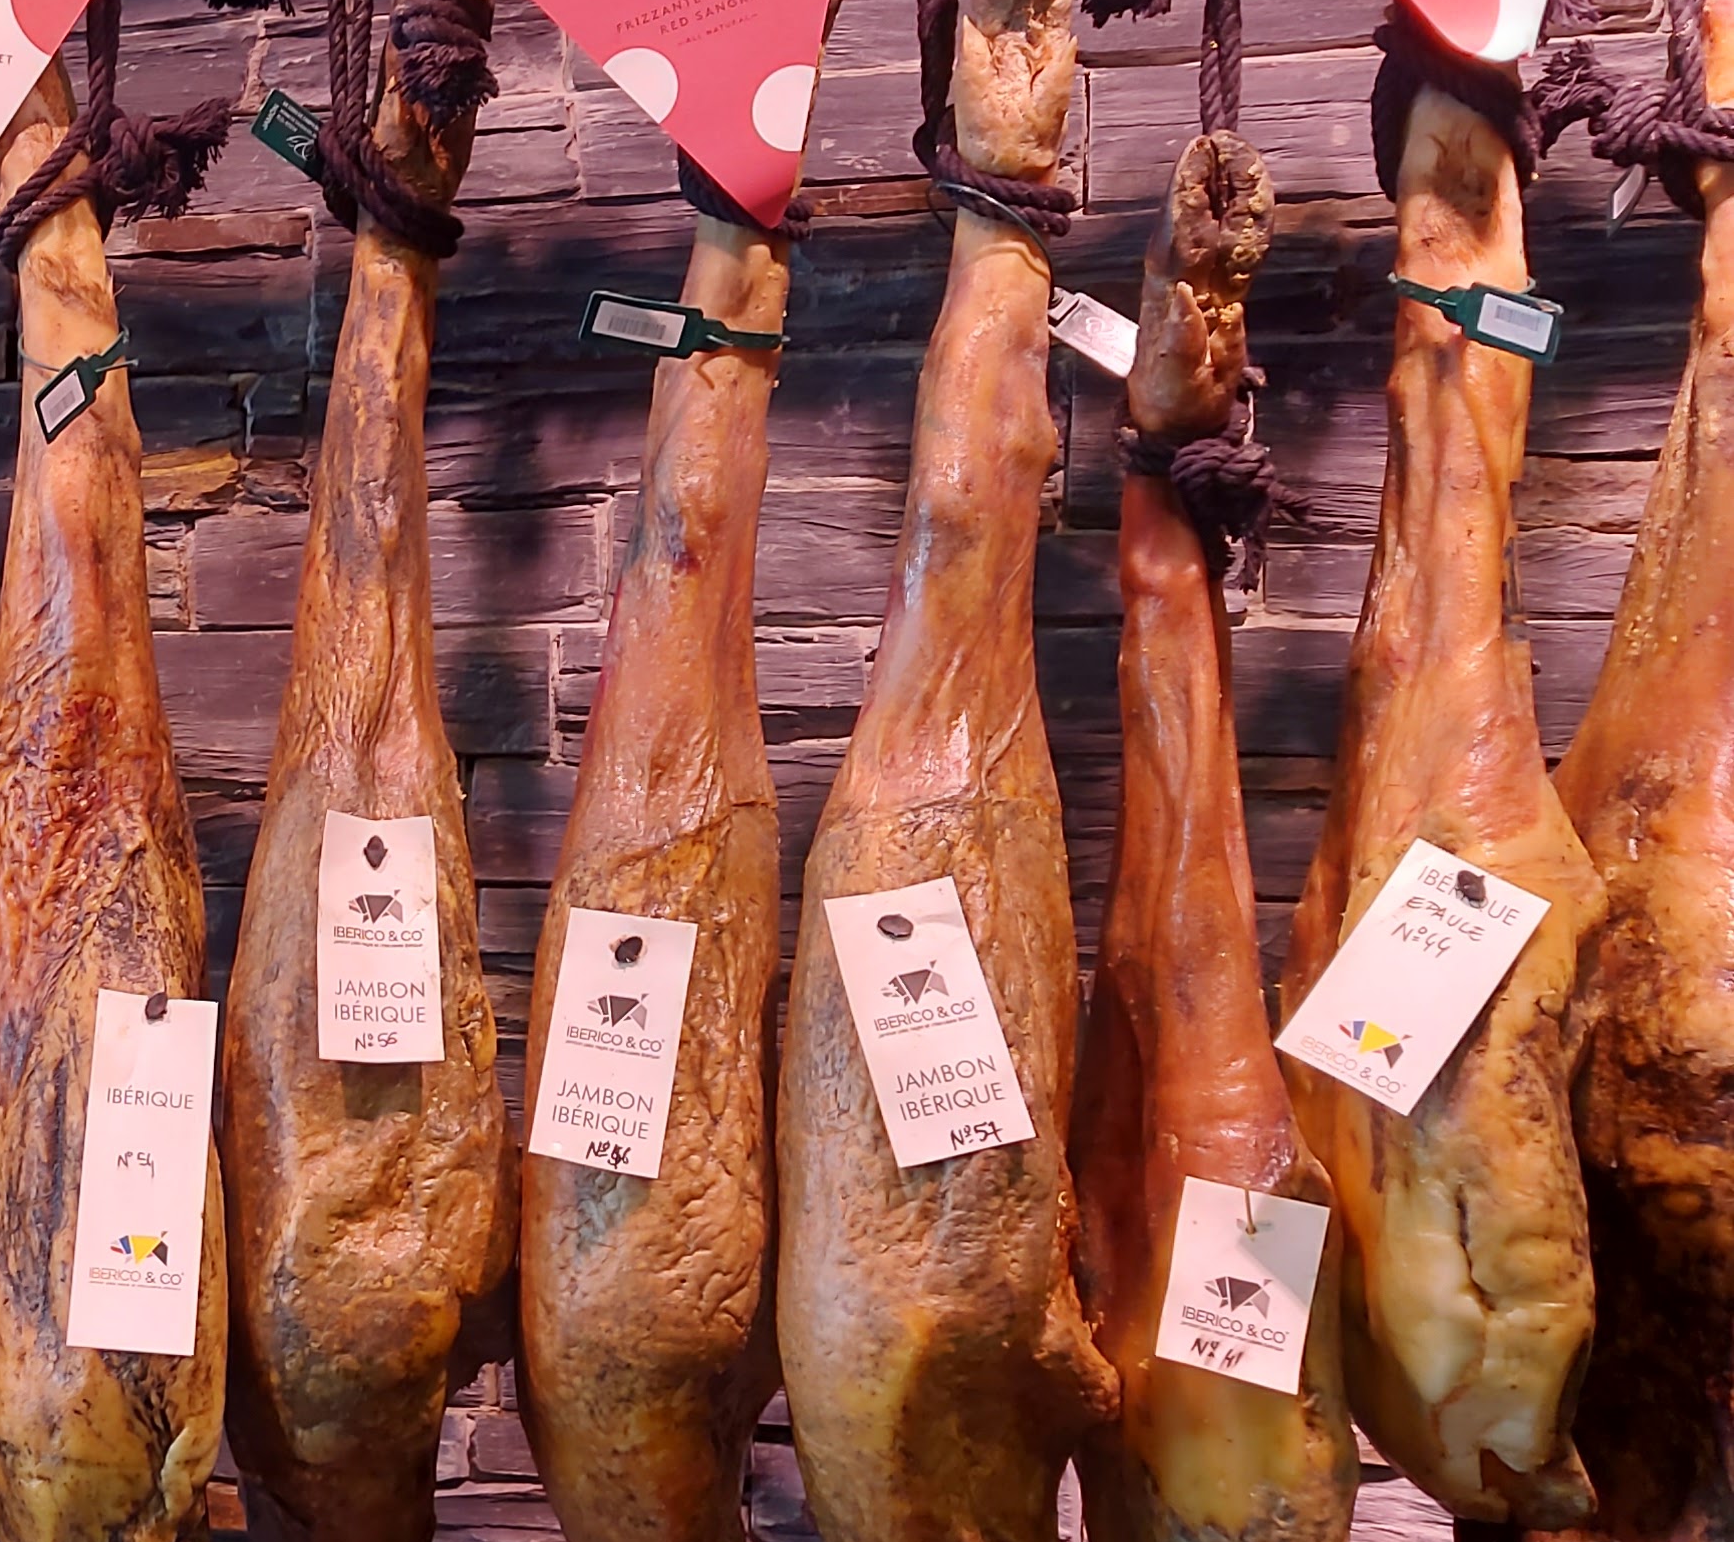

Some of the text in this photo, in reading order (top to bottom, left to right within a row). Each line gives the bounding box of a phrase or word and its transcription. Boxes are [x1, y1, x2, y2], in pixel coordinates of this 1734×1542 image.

[660, 18, 689, 35] RED
[333, 925, 423, 942] IBERICO & CO
[335, 978, 425, 999] JAMBON
[334, 1000, 427, 1023] IBÉRIQUE
[874, 1008, 934, 1031] IBERICO
[937, 1006, 950, 1019] &
[951, 1000, 975, 1016] CO
[566, 1025, 623, 1046] IBERICO
[625, 1036, 637, 1049] &
[639, 1038, 663, 1053] CO
[896, 1055, 996, 1094] JAMBON
[1360, 1066, 1372, 1081] &
[1375, 1075, 1401, 1095] CO
[106, 1084, 195, 1110] IBÉRIQUE
[557, 1078, 654, 1114] JAMBON
[900, 1082, 1006, 1121] IBÉRIQUE
[552, 1104, 650, 1140] IBÉRIQUE
[89, 1267, 141, 1283] IBERICO
[145, 1271, 157, 1285] &
[160, 1272, 183, 1286] CO
[1182, 1305, 1243, 1333] IBERICO
[1246, 1323, 1258, 1338] &
[1261, 1328, 1285, 1344] CO
